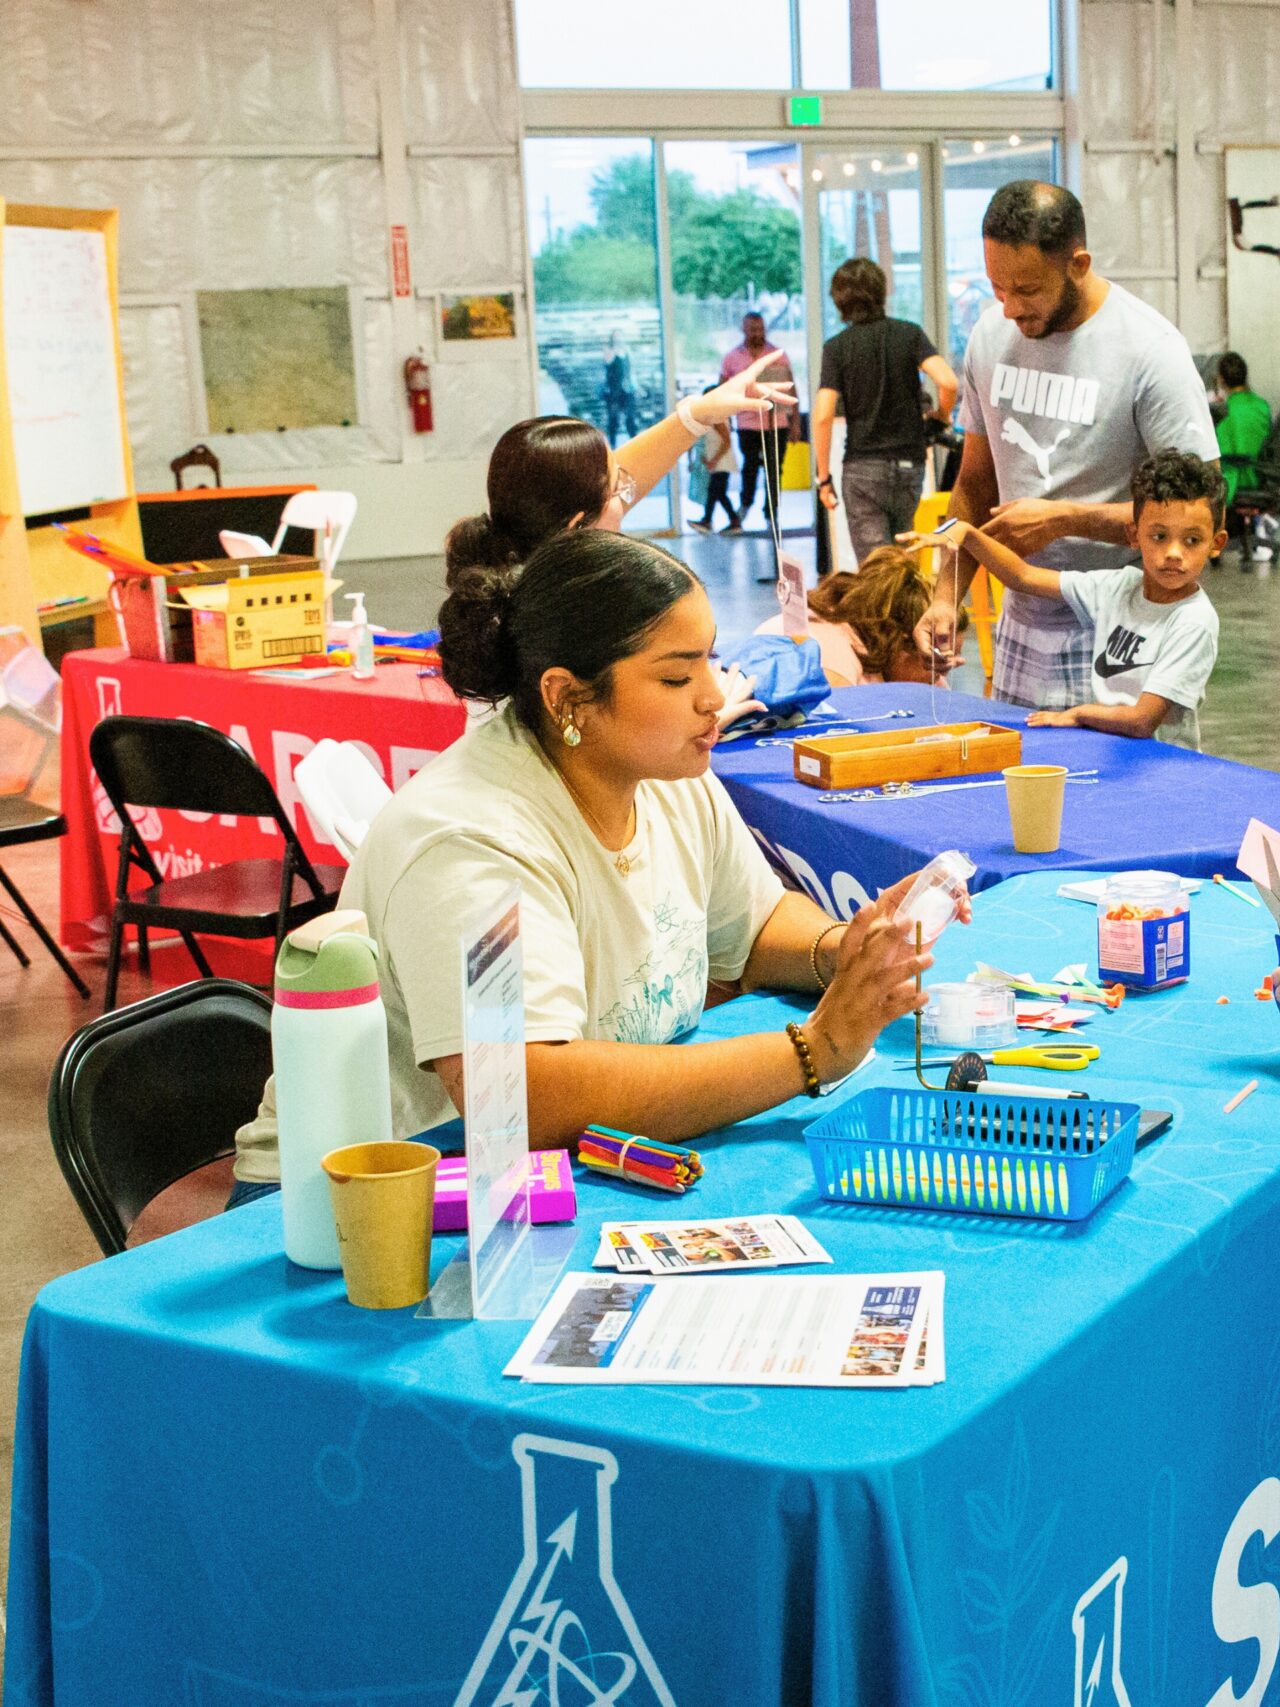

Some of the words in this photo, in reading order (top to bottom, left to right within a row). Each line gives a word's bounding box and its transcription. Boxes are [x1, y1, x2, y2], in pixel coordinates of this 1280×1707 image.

[990, 363, 1100, 425] PUMA
[1107, 625, 1146, 665] NIKE
[540, 1152, 562, 1190] Straws
